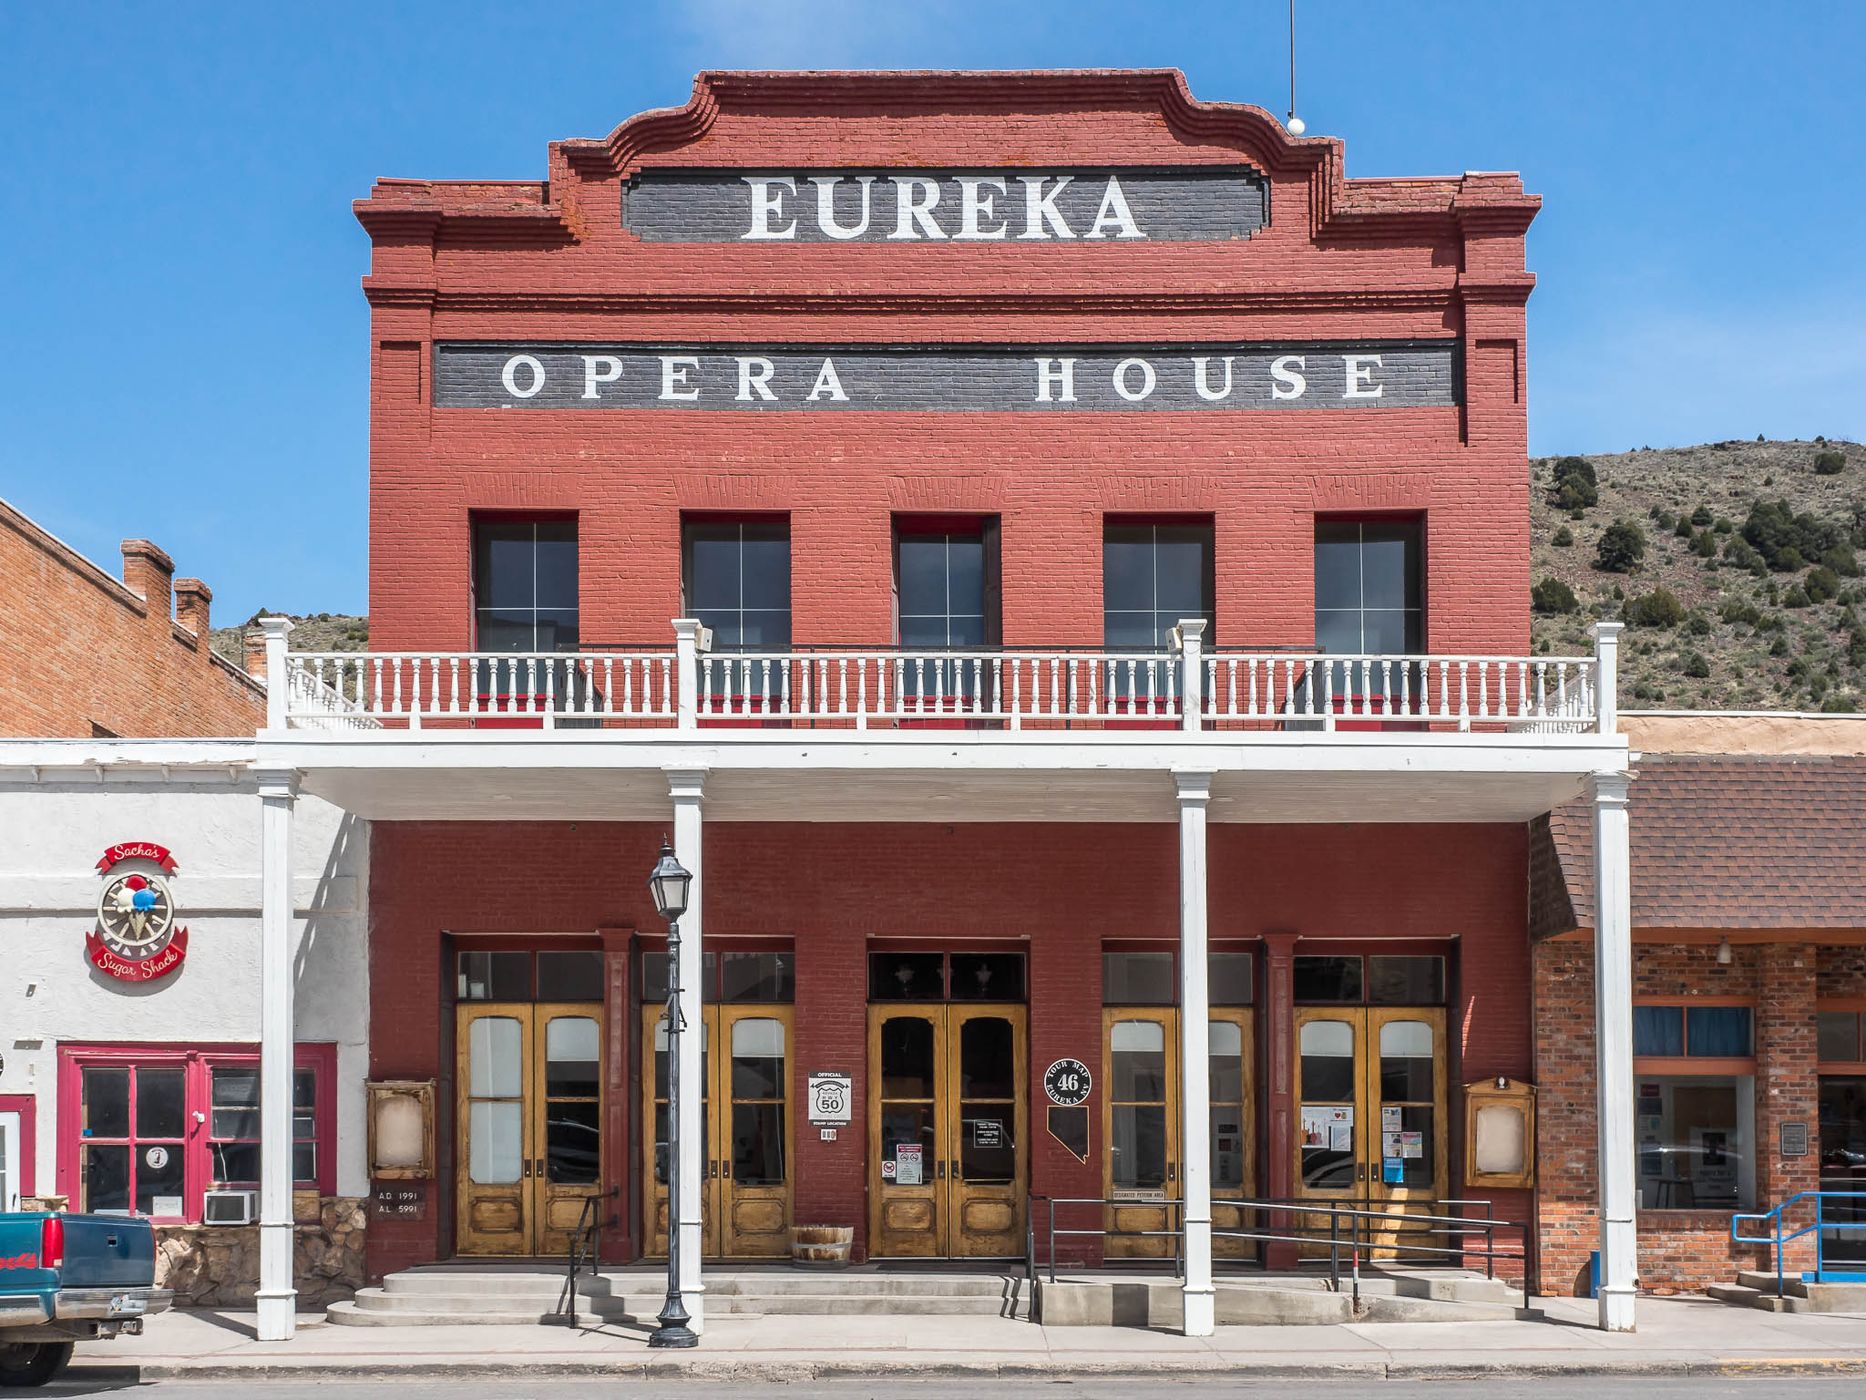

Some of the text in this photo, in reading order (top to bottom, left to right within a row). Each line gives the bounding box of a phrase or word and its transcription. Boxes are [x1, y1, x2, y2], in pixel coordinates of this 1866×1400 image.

[741, 175, 1147, 242] EUREKA
[501, 354, 1384, 403] OPERA HOUSE
[114, 845, 159, 860] Sacha's
[97, 950, 177, 978] Sugar Shack
[1048, 1061, 1088, 1077] TOUR MAP
[1057, 1074, 1078, 1090] 46
[1046, 1084, 1088, 1104] EUREKA NV
[822, 1100, 838, 1109] 50
